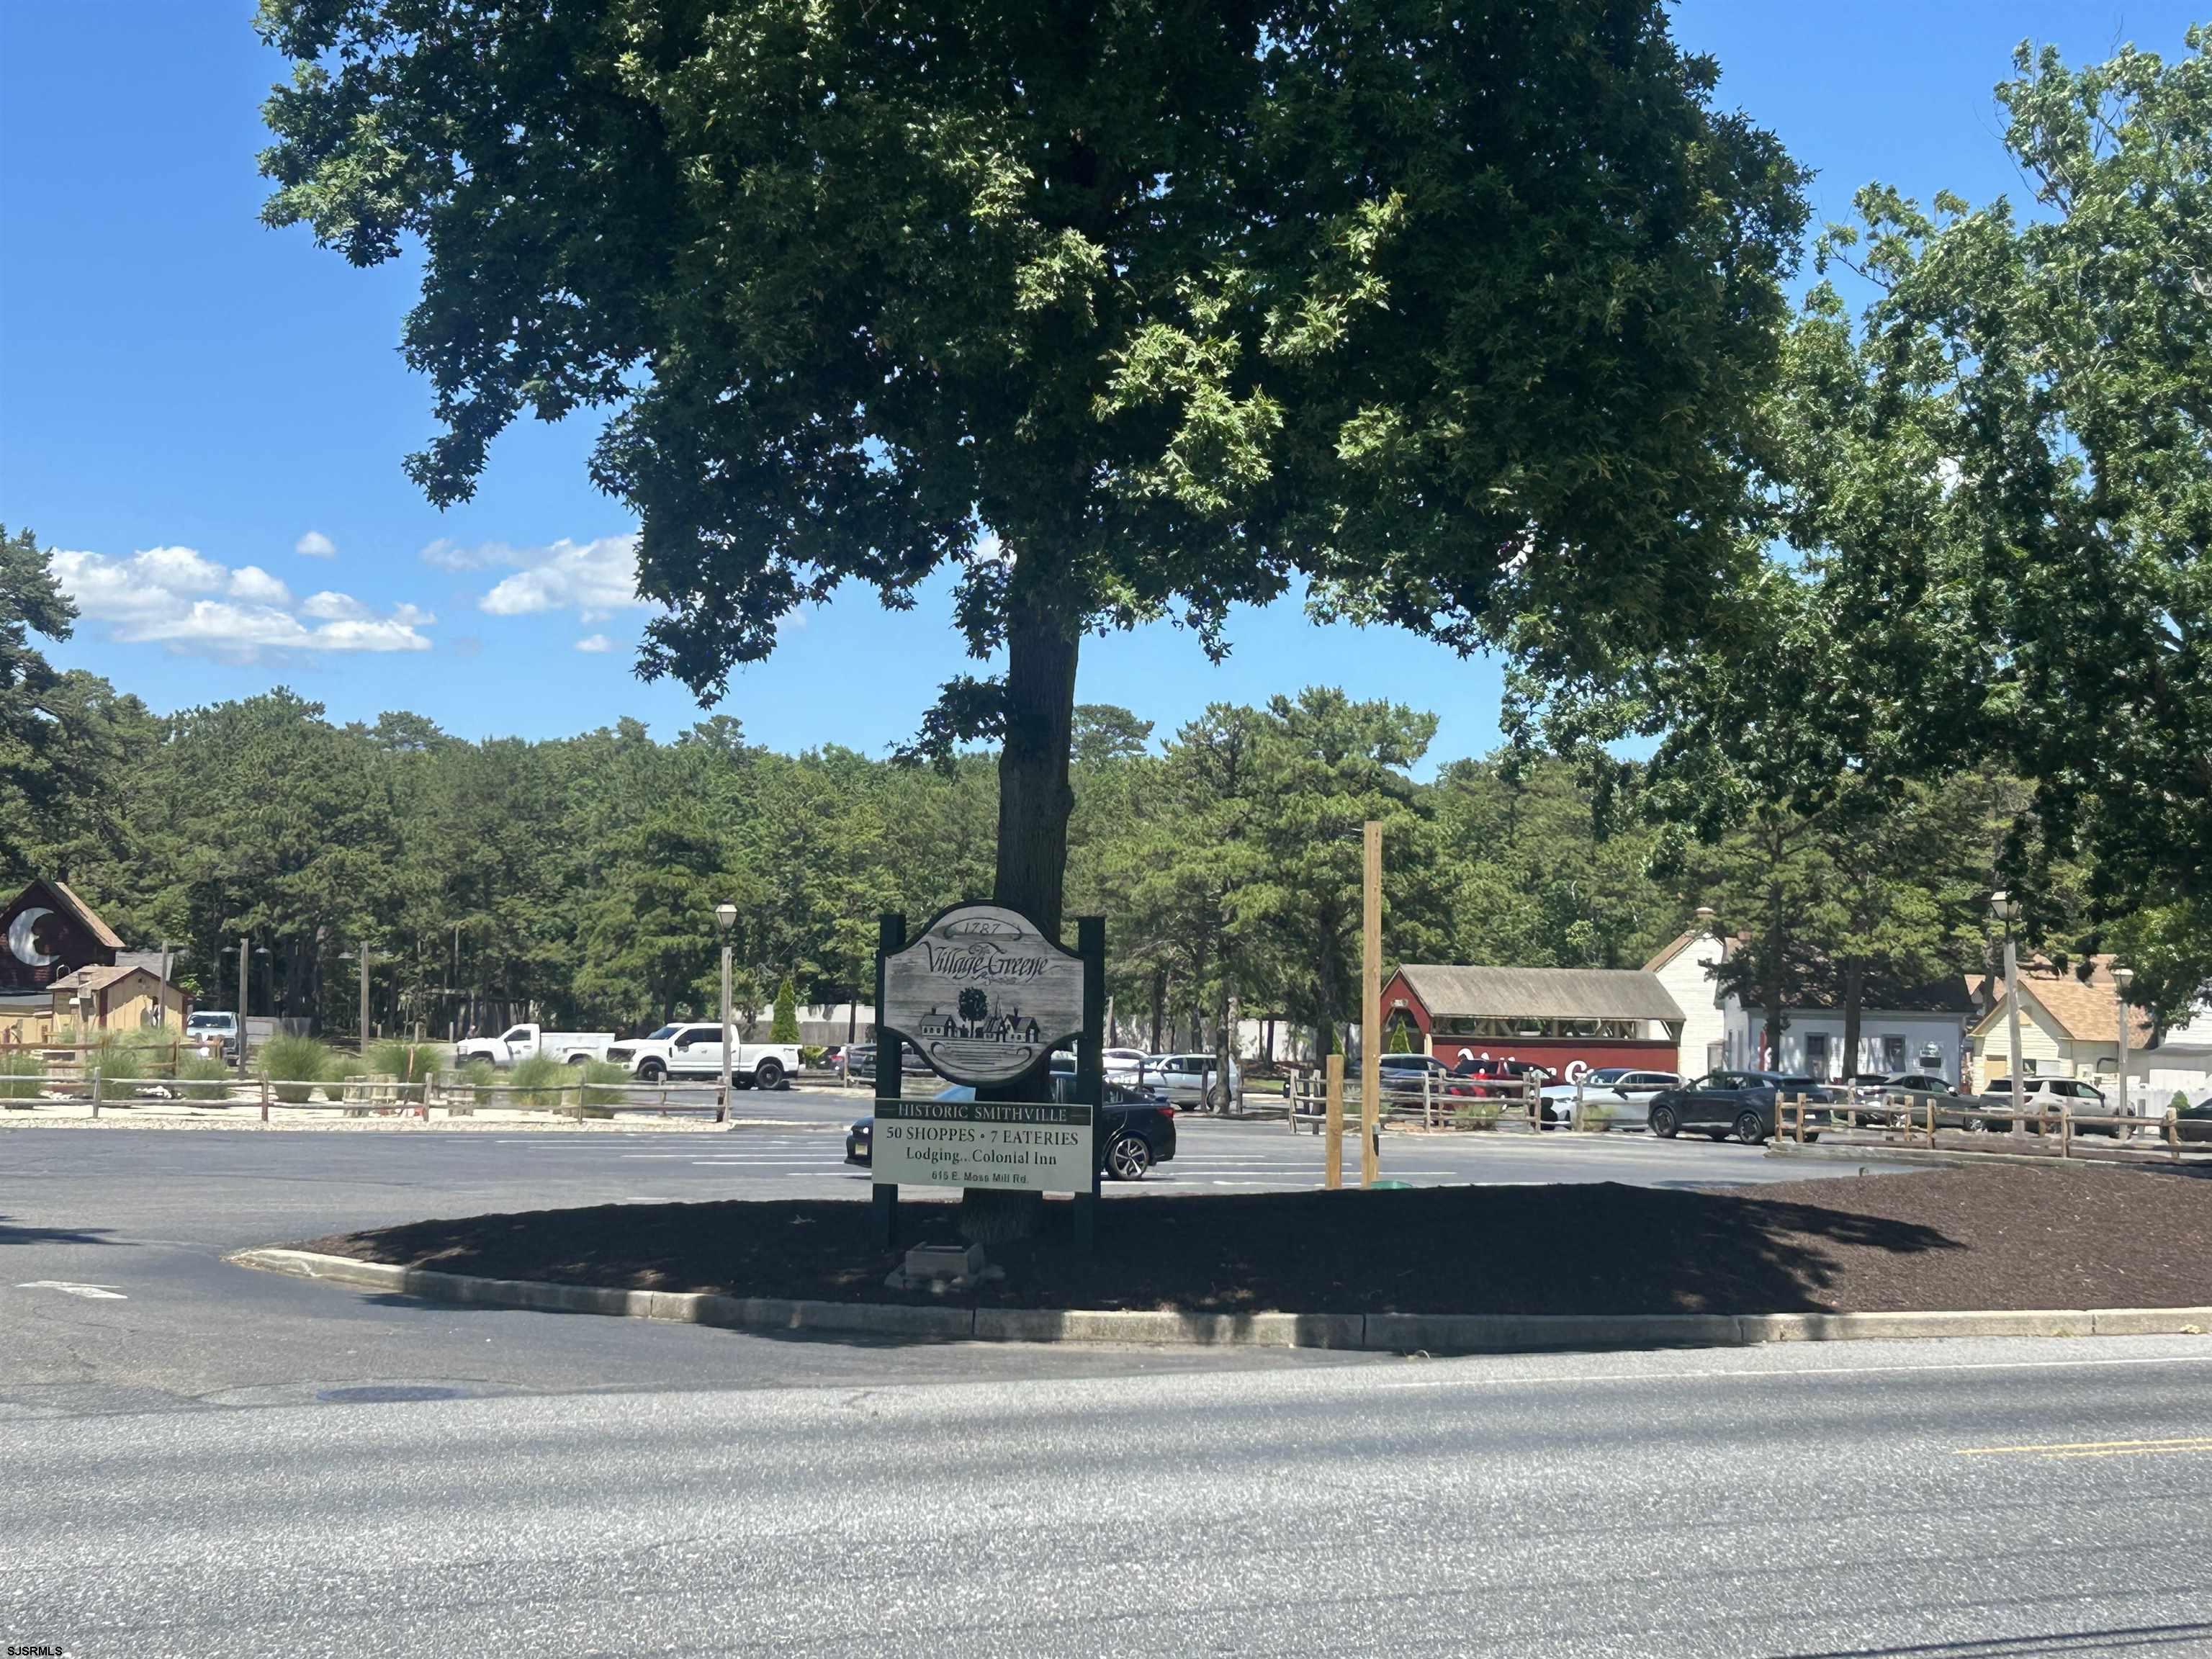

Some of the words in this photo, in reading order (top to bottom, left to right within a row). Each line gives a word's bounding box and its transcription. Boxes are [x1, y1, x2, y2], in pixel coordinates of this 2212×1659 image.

[964, 922, 1001, 935] 1787
[919, 941, 985, 979] Village
[899, 1104, 968, 1118] HISTORIC
[974, 1106, 1066, 1122] SMITHVILLE
[886, 1127, 902, 1138] 50
[907, 1127, 975, 1142] SHOPPES
[991, 1130, 998, 1143] 7
[1003, 1130, 1078, 1145] EATERIES
[972, 1149, 1029, 1164] Colonial
[1034, 1151, 1057, 1165] Inn
[963, 1172, 989, 1182] Moss
[992, 1173, 1010, 1183] Mill
